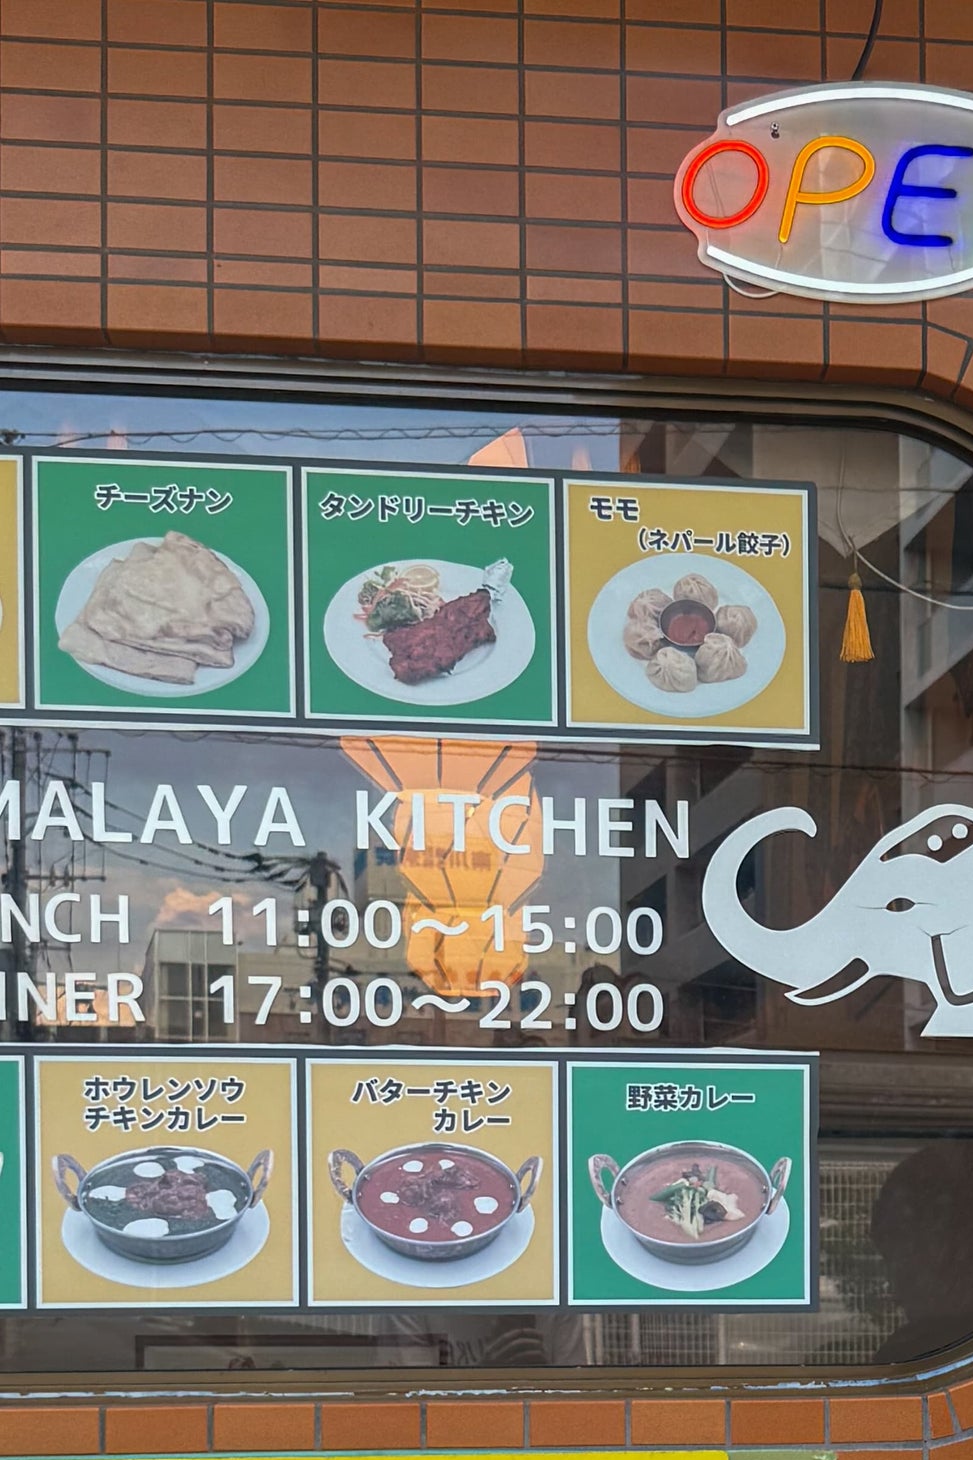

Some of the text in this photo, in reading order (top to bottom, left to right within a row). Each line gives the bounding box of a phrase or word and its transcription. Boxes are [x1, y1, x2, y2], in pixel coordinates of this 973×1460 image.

[95, 483, 233, 514] チーズナン
[319, 491, 535, 528] タンドリーチキン
[589, 497, 640, 522] モモ
[637, 527, 792, 557] (ネパール餃子)
[355, 789, 691, 859] KITCHEN
[0, 971, 147, 1023] NER
[83, 1075, 246, 1103] ホウレンソウ
[351, 1077, 513, 1105] バターチキン
[626, 1083, 755, 1111] 野菜カレー
[83, 1105, 247, 1132] チキンカレー
[433, 1107, 512, 1133] カレー
